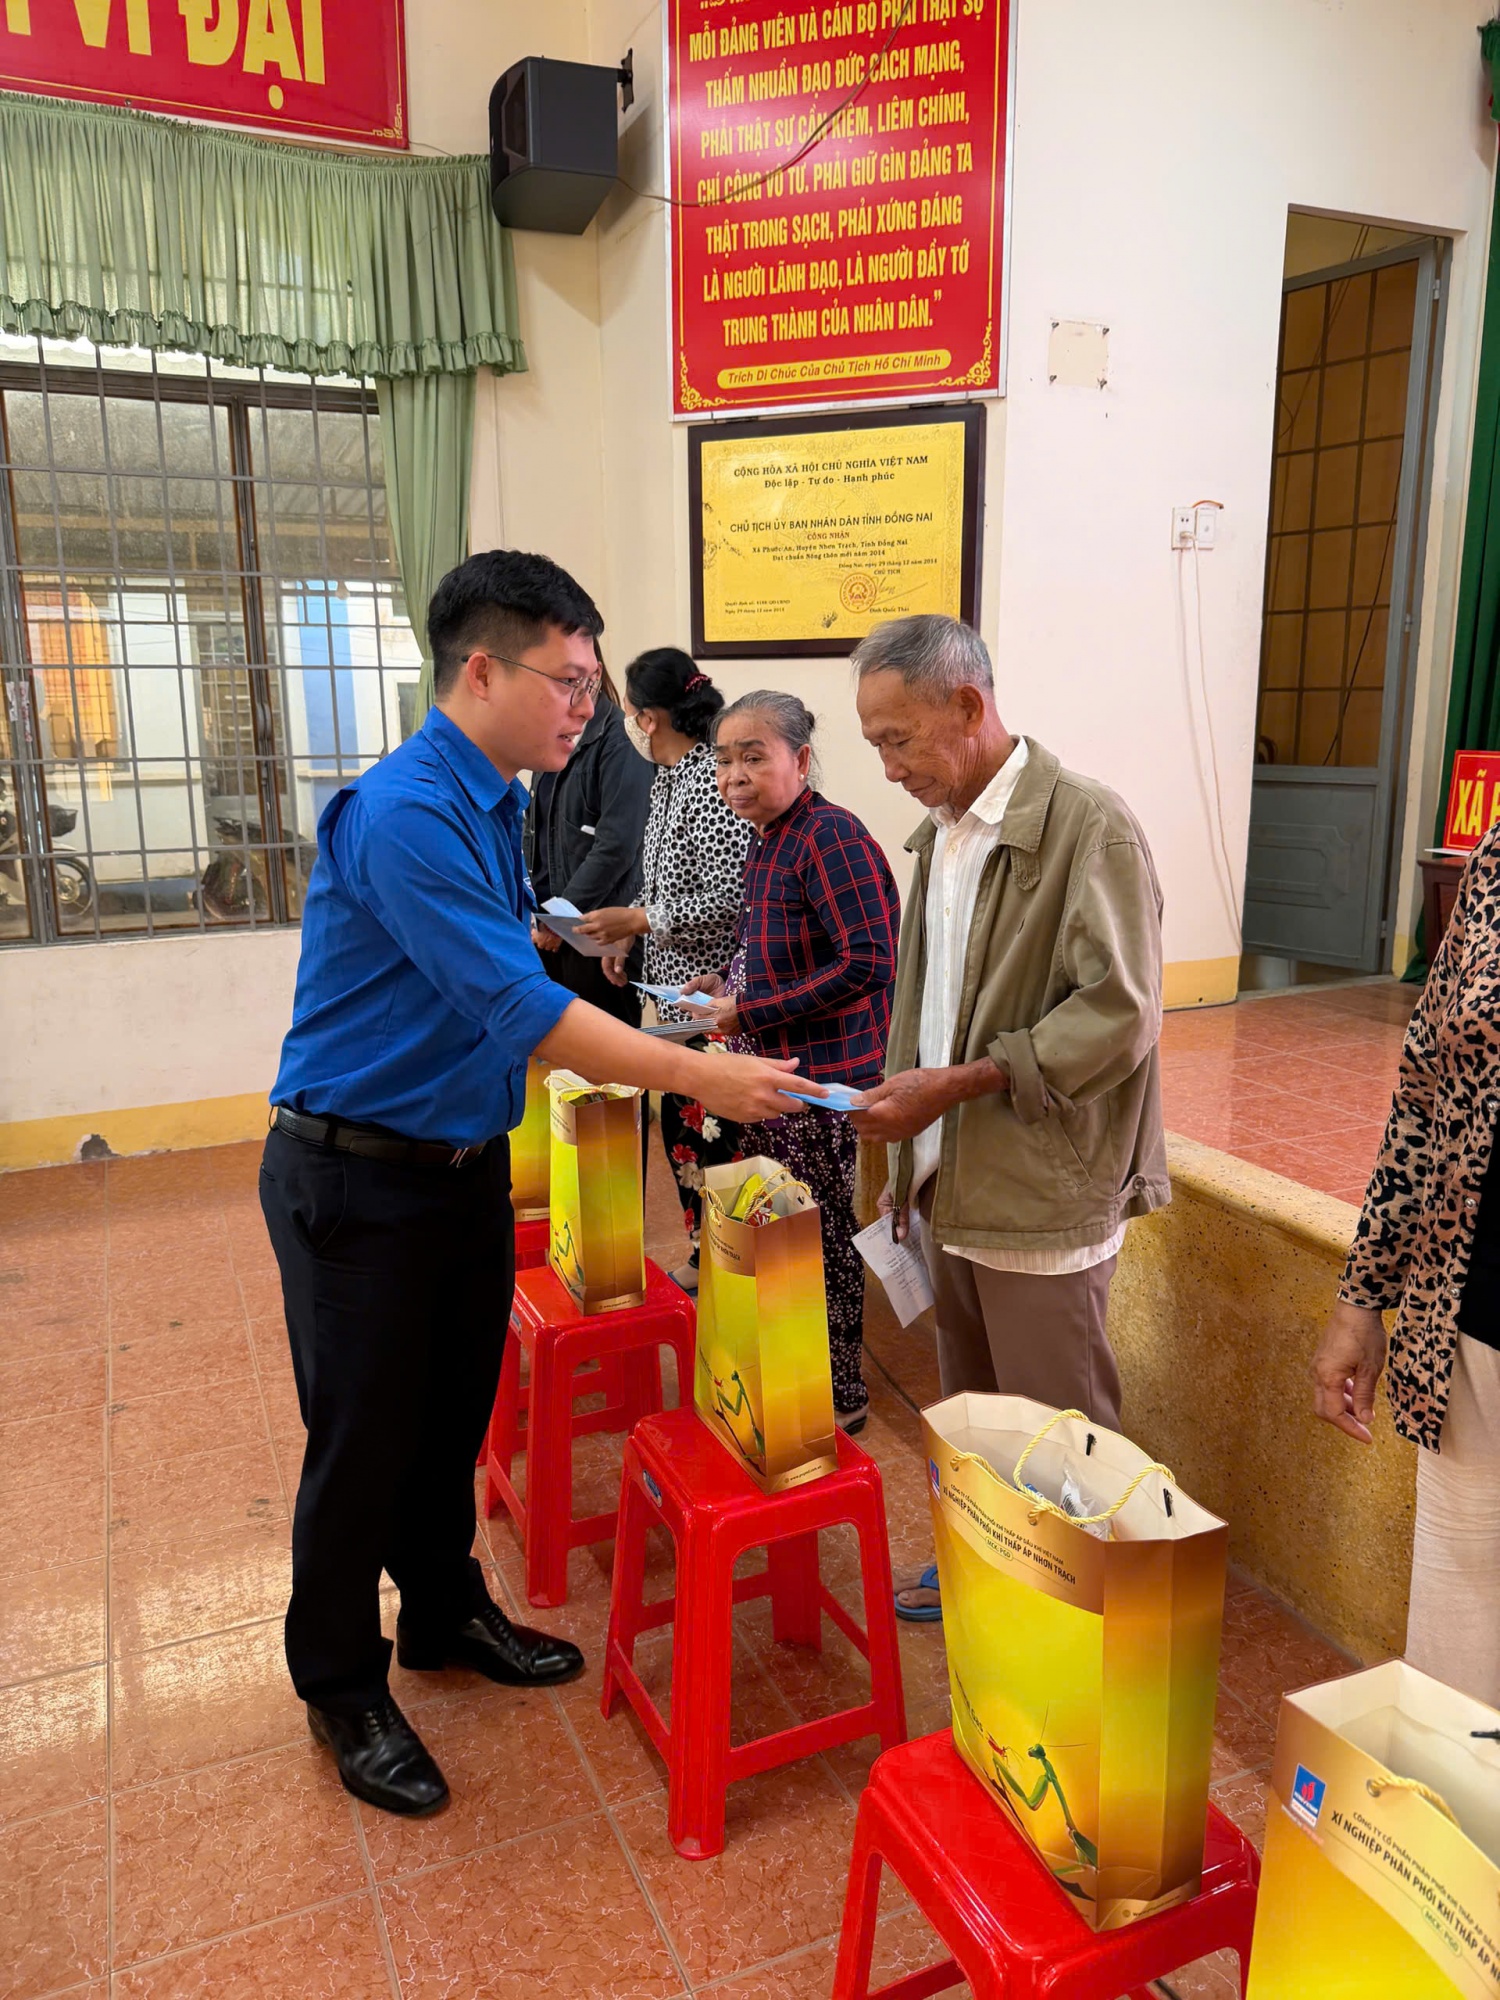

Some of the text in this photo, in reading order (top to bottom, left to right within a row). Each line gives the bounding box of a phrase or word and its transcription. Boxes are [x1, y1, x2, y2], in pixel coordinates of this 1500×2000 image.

[689, 20, 716, 62] MỖI
[719, 16, 759, 57] ĐẢNG
[762, 11, 795, 49] VIÊN
[799, 6, 818, 43] VÀ
[822, 1, 853, 39] CÁN
[857, 0, 877, 38] BỘ
[705, 67, 745, 109] THẤM
[749, 57, 798, 102] NHUẦN
[802, 61, 831, 99] ĐẠO
[835, 51, 865, 89] ĐỨC
[914, 39, 965, 81] MẠNG,
[701, 87, 970, 159] PHẢI THẬT SỰ CẦN KIỆM, LIÊM CHÍNH,
[698, 138, 973, 207] CHÍ CÔNG VÔ TƯ. PHẢI GIỮ GÌN ĐẢNG TA
[705, 190, 963, 259] THẬT TRONG SẠCH, PHẢI XỨNG ĐÁNG
[703, 238, 970, 302] LÀ NGƯỜI LÃNH ĐẠO, LÀ NGƯỜI ĐẦY TỚ
[723, 315, 768, 346] TRUNG
[771, 306, 817, 341] THÀNH
[821, 298, 849, 337] CỦA
[854, 297, 894, 333] NHÂN
[728, 353, 941, 384] Trích Di Chúc Của Chủ Tịch Hồ Chí Minh
[734, 466, 760, 478] CỘNG
[763, 465, 782, 475] HÒA
[802, 463, 819, 474] HỘI
[822, 460, 843, 471] CHỦ
[845, 459, 876, 469] NGHĨA
[879, 457, 902, 468] VIỆT
[906, 455, 928, 465] NAM
[764, 477, 782, 488] Độc
[784, 478, 799, 489] lập
[808, 477, 820, 487] Tự
[843, 473, 868, 484] Hạnh
[871, 472, 895, 483] phúc
[730, 519, 749, 532] CHỦ
[752, 522, 771, 533] TỊCH
[789, 519, 807, 529] BAN
[810, 516, 837, 528] NHÂN
[839, 514, 860, 526] DÂN
[885, 511, 913, 523] ĐỒNG
[916, 512, 933, 522] NAI
[807, 532, 827, 541] CÔNG
[869, 549, 885, 557] 2014
[1452, 768, 1487, 836] XÃ
[992, 1528, 1003, 1543] KHÍ
[1004, 1535, 1022, 1551] THẤP
[1023, 1546, 1032, 1558] ÁP
[1033, 1553, 1053, 1571] NHƠN
[1054, 1564, 1076, 1584] TRẠCH
[1353, 1811, 1372, 1831] CÔNG
[1373, 1826, 1382, 1837] TY
[1331, 1810, 1344, 1826] XÍ
[1343, 1820, 1382, 1854] NGHIỆP
[1383, 1850, 1411, 1882] PHÂN
[1413, 1874, 1437, 1905] PHỐI
[1437, 1900, 1454, 1924] KHÍ
[1454, 1918, 1478, 1950] THẤP
[1477, 1945, 1490, 1966] ÁP
